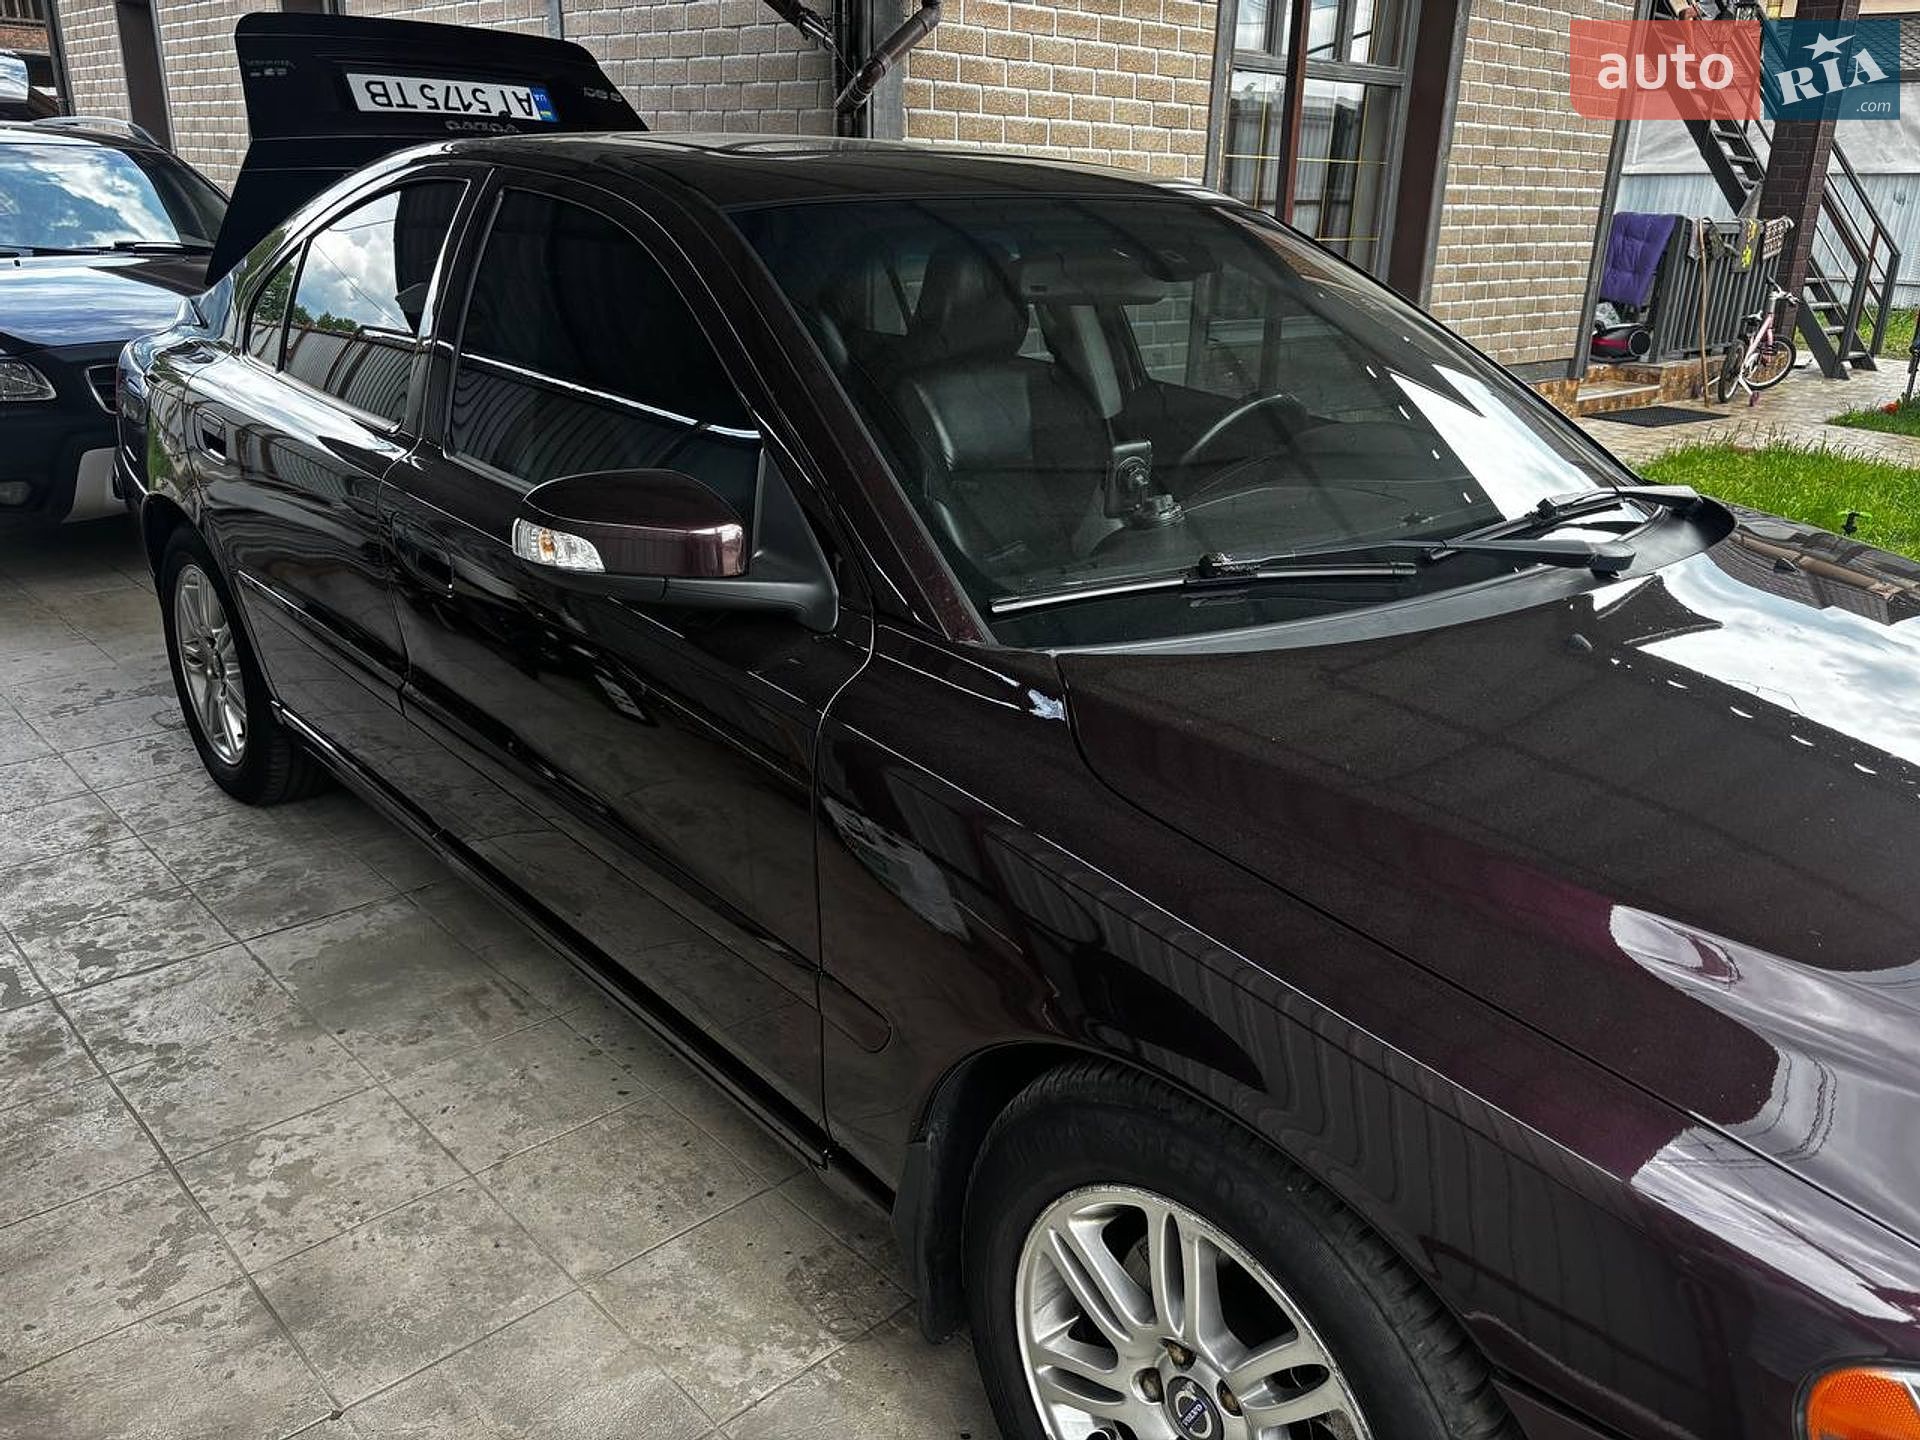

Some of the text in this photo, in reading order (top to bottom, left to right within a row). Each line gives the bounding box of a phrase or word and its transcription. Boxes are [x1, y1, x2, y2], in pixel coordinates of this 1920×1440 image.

[365, 80, 418, 108] TB
[419, 83, 492, 113] 5175
[445, 120, 521, 132] VOLVO
